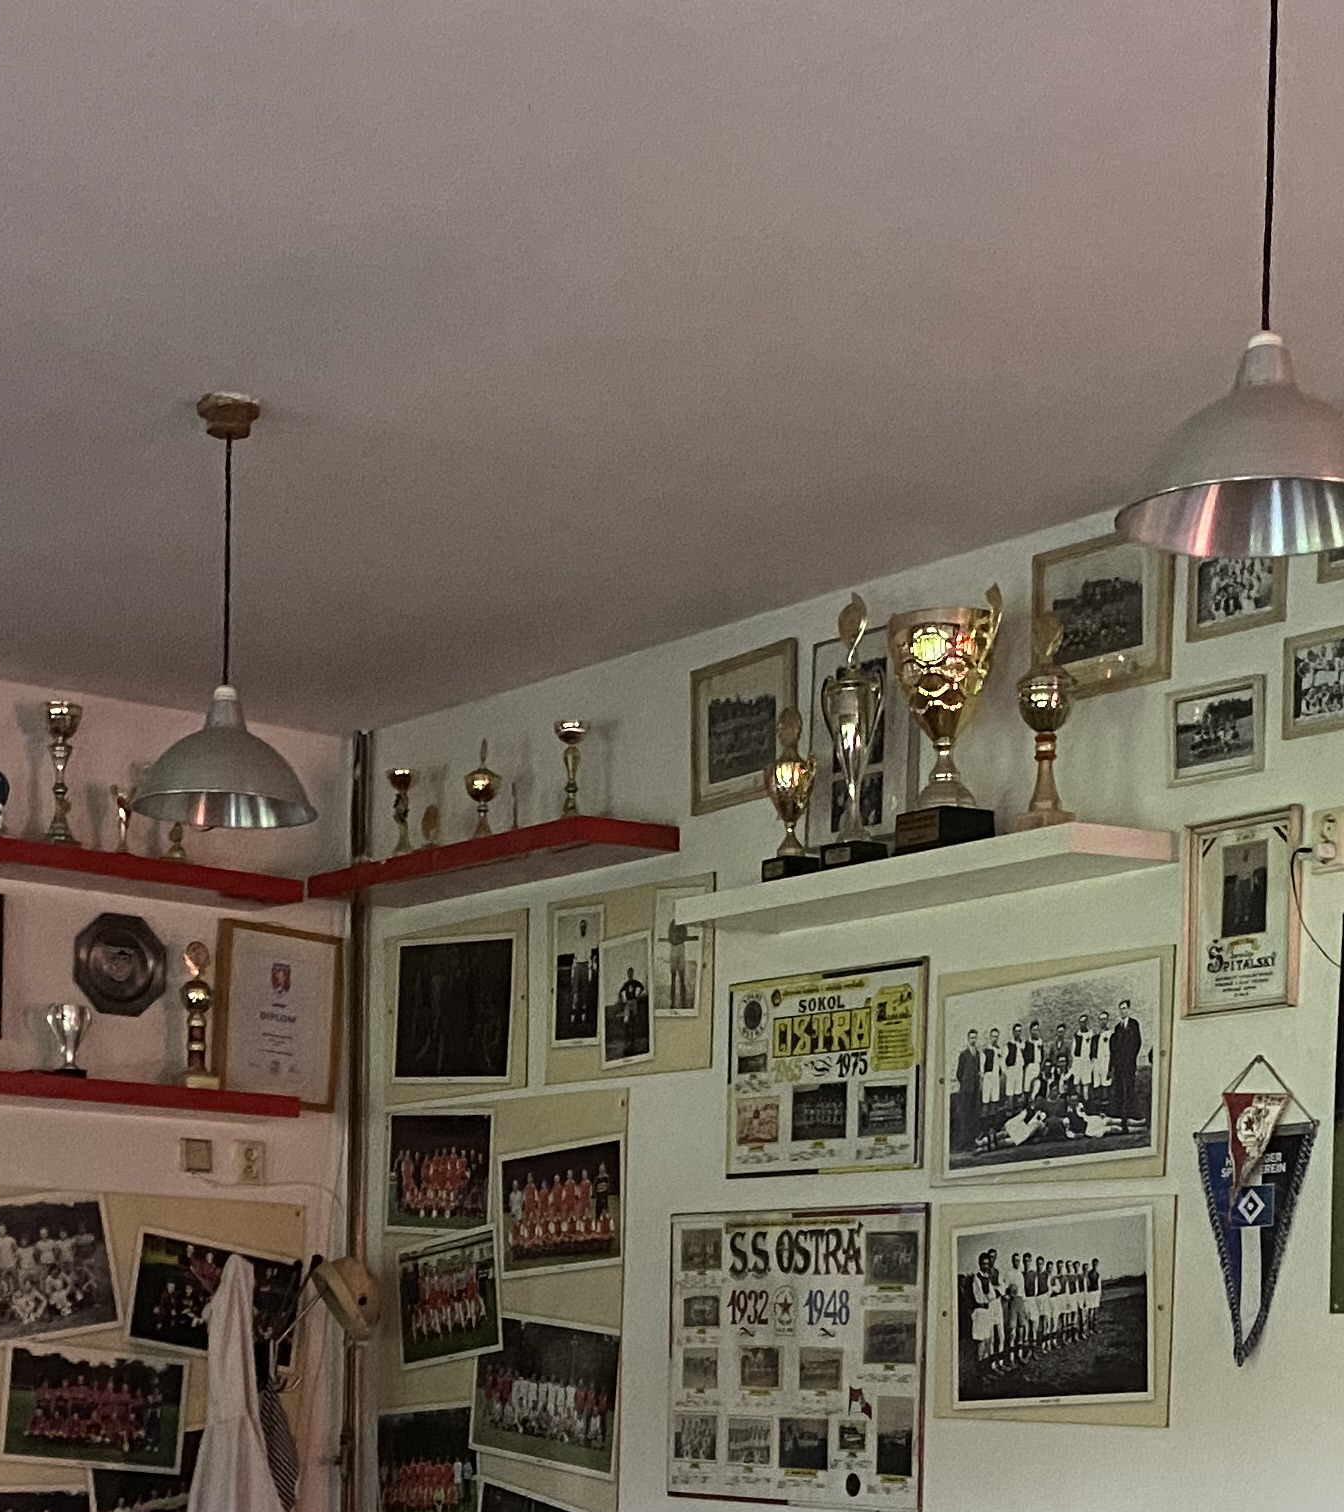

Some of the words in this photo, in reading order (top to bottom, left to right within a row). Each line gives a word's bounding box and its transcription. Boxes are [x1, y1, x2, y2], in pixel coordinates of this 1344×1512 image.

[798, 995, 845, 1013] SOKOL
[836, 1052, 868, 1077] 1975
[727, 1289, 769, 1325] 1932
[803, 1289, 850, 1326] 1948
